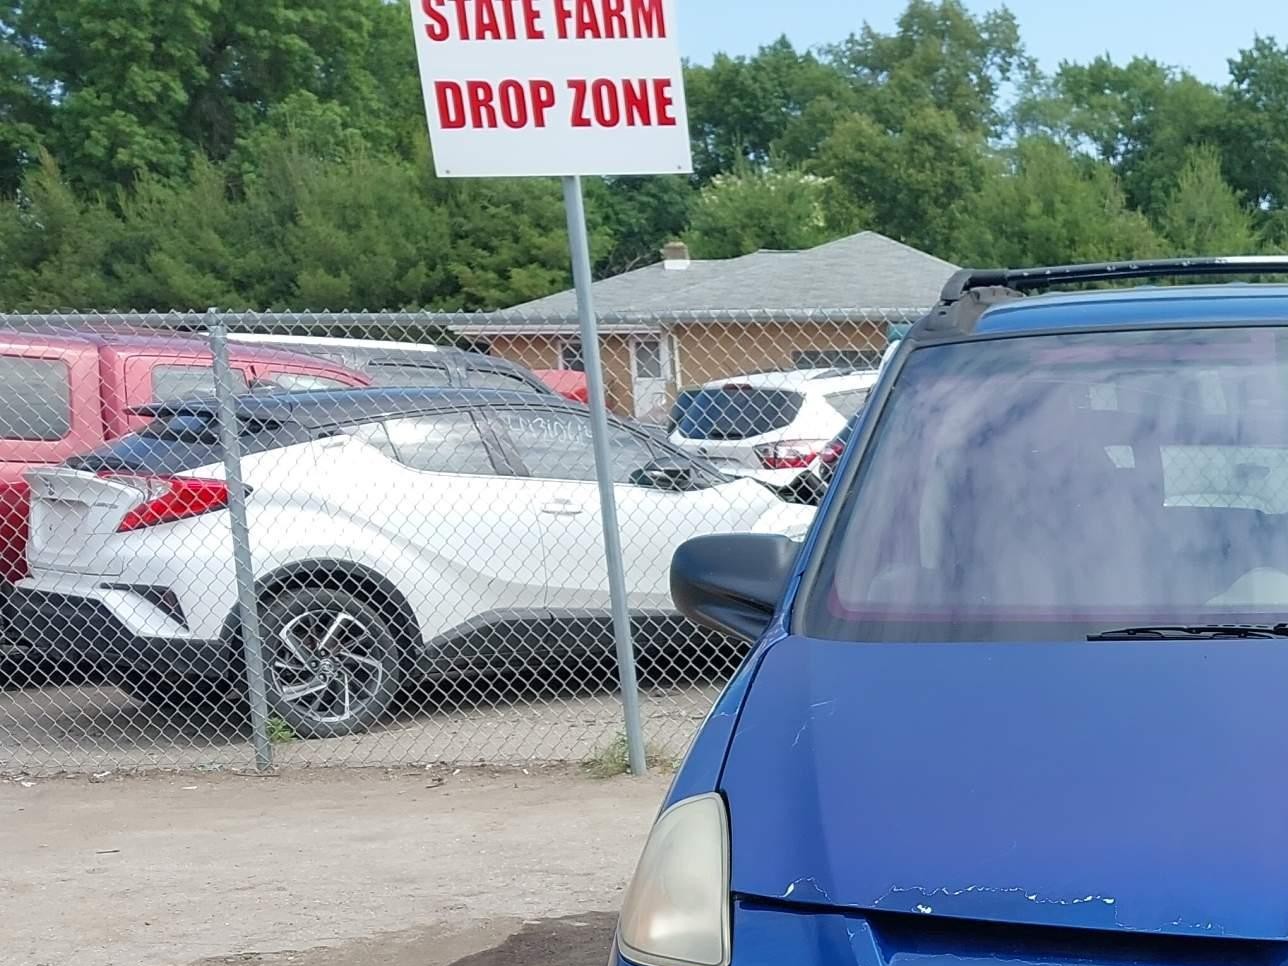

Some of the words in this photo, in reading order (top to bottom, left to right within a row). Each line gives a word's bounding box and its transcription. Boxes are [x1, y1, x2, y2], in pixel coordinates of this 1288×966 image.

[423, 0, 544, 41] STATE
[554, 0, 667, 39] FARM
[435, 80, 556, 129] DROP
[568, 79, 676, 128] ZONE
